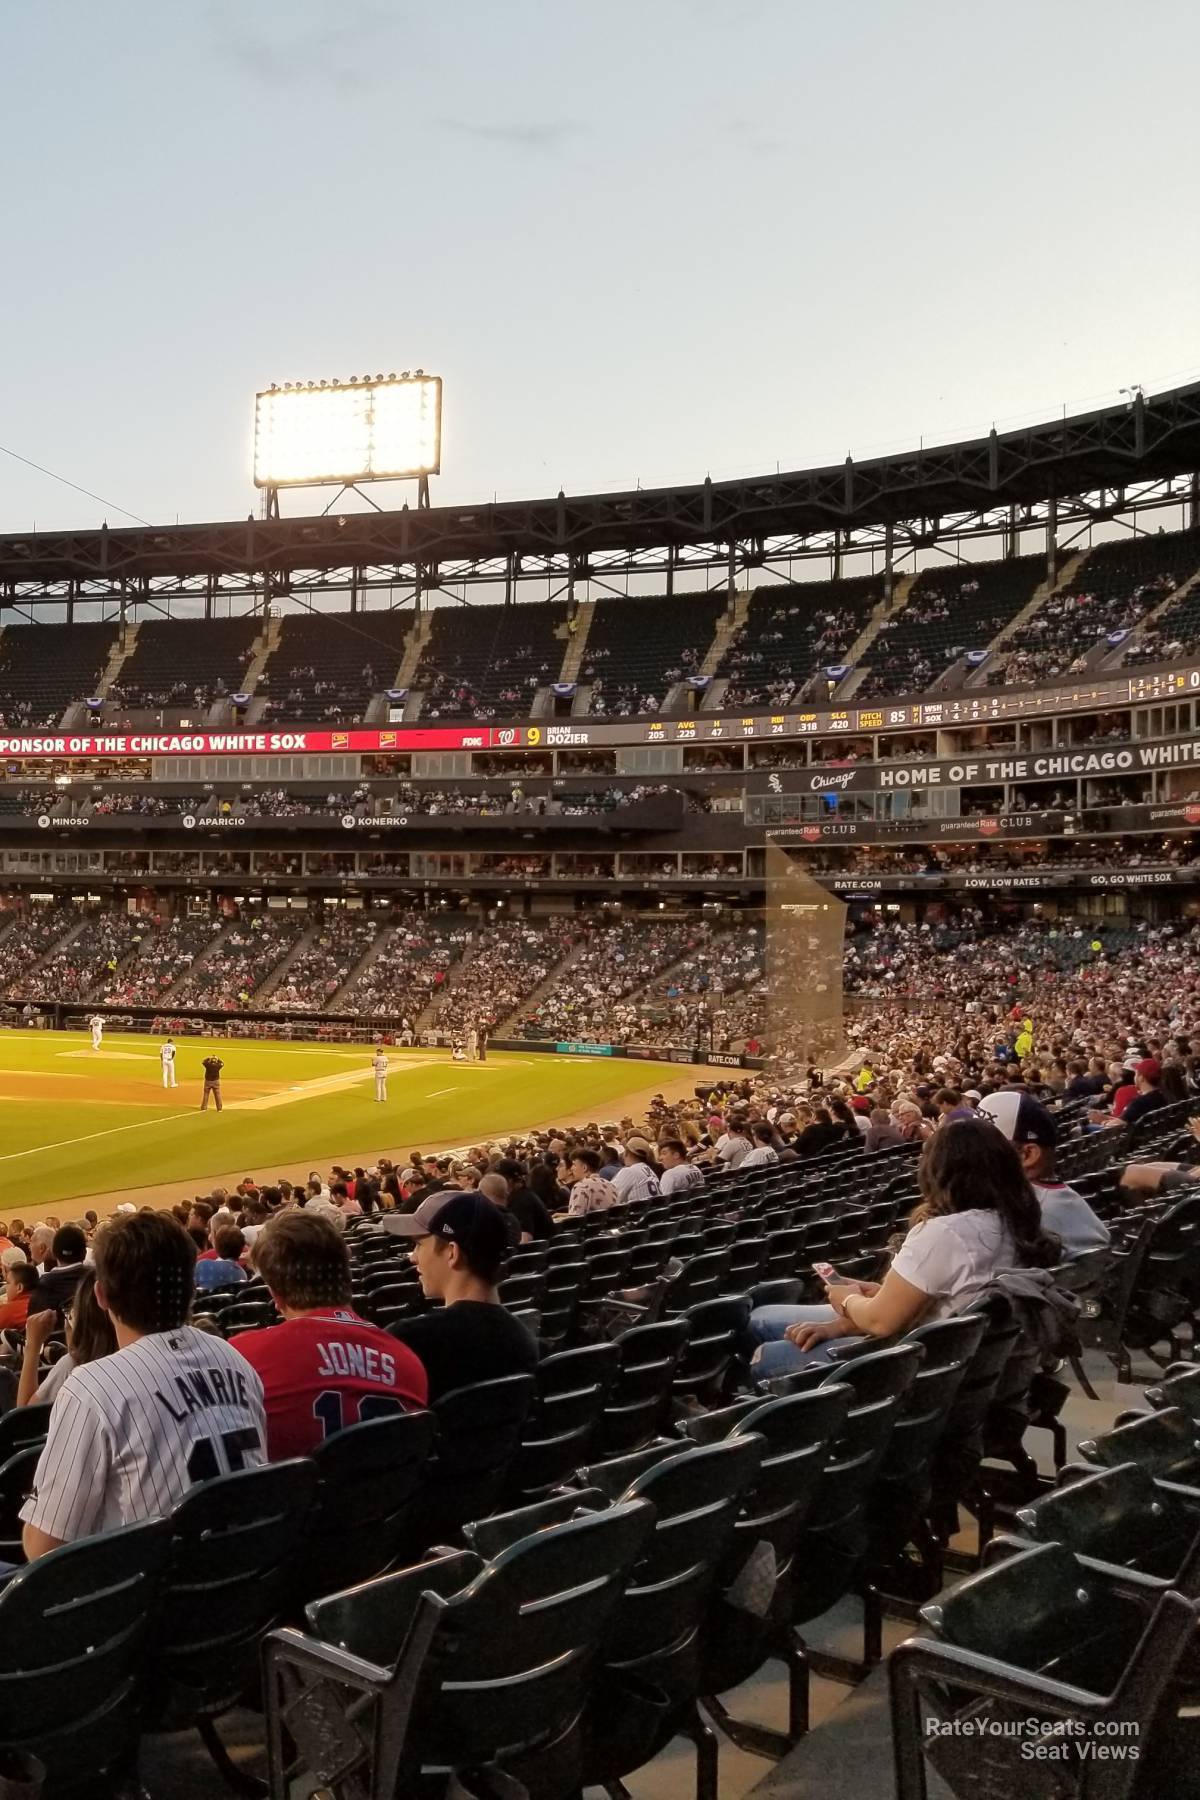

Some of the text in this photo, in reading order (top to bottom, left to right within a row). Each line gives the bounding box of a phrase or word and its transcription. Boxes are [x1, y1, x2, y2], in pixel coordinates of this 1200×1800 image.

[1138, 679, 1144, 687] 2
[1168, 674, 1174, 682] 0
[1177, 676, 1185, 687] B
[1190, 671, 1200, 687] 0
[924, 704, 943, 713] WSH
[953, 702, 960, 710] 2
[992, 698, 998, 706] 0
[650, 722, 662, 730] AB
[677, 721, 695, 729] AVG
[742, 718, 754, 726] HR
[771, 716, 784, 724] RBI
[799, 713, 817, 722] OBP
[831, 711, 847, 720] SLG
[860, 712, 882, 720] PITCH
[890, 710, 906, 723] 85
[925, 714, 942, 723] SOX
[648, 720, 849, 740] 205 .229 47 10 24 .318 .420
[859, 719, 882, 728] SPEED
[527, 727, 541, 745] 9
[546, 726, 571, 735] BRIAN
[69, 738, 91, 752] OF
[94, 737, 127, 752] THE
[130, 736, 205, 751] CHICAGO
[208, 735, 266, 750] WHITE
[270, 734, 306, 749] SOX
[546, 733, 589, 744] DOZIER
[880, 742, 1200, 786] HOME OF THE CHICAGO WHITE
[810, 771, 857, 790] Chicago
[1149, 808, 1186, 821] guaranteed
[52, 818, 90, 826] MINOSO
[198, 817, 246, 826] APARICIO
[358, 817, 408, 826] KONERKO
[940, 817, 1033, 832] guaranteed Rate CLUB
[765, 827, 803, 837] guaranteed
[822, 825, 857, 835] CLUB
[834, 881, 882, 889] RATE.COM
[965, 878, 1040, 888] LOW, LOW RATES
[1090, 873, 1171, 885] GO, GO WHITE SOX
[707, 1054, 740, 1066] RATE.COM
[316, 1342, 396, 1386] JONES
[154, 1367, 250, 1423] LAWRIE
